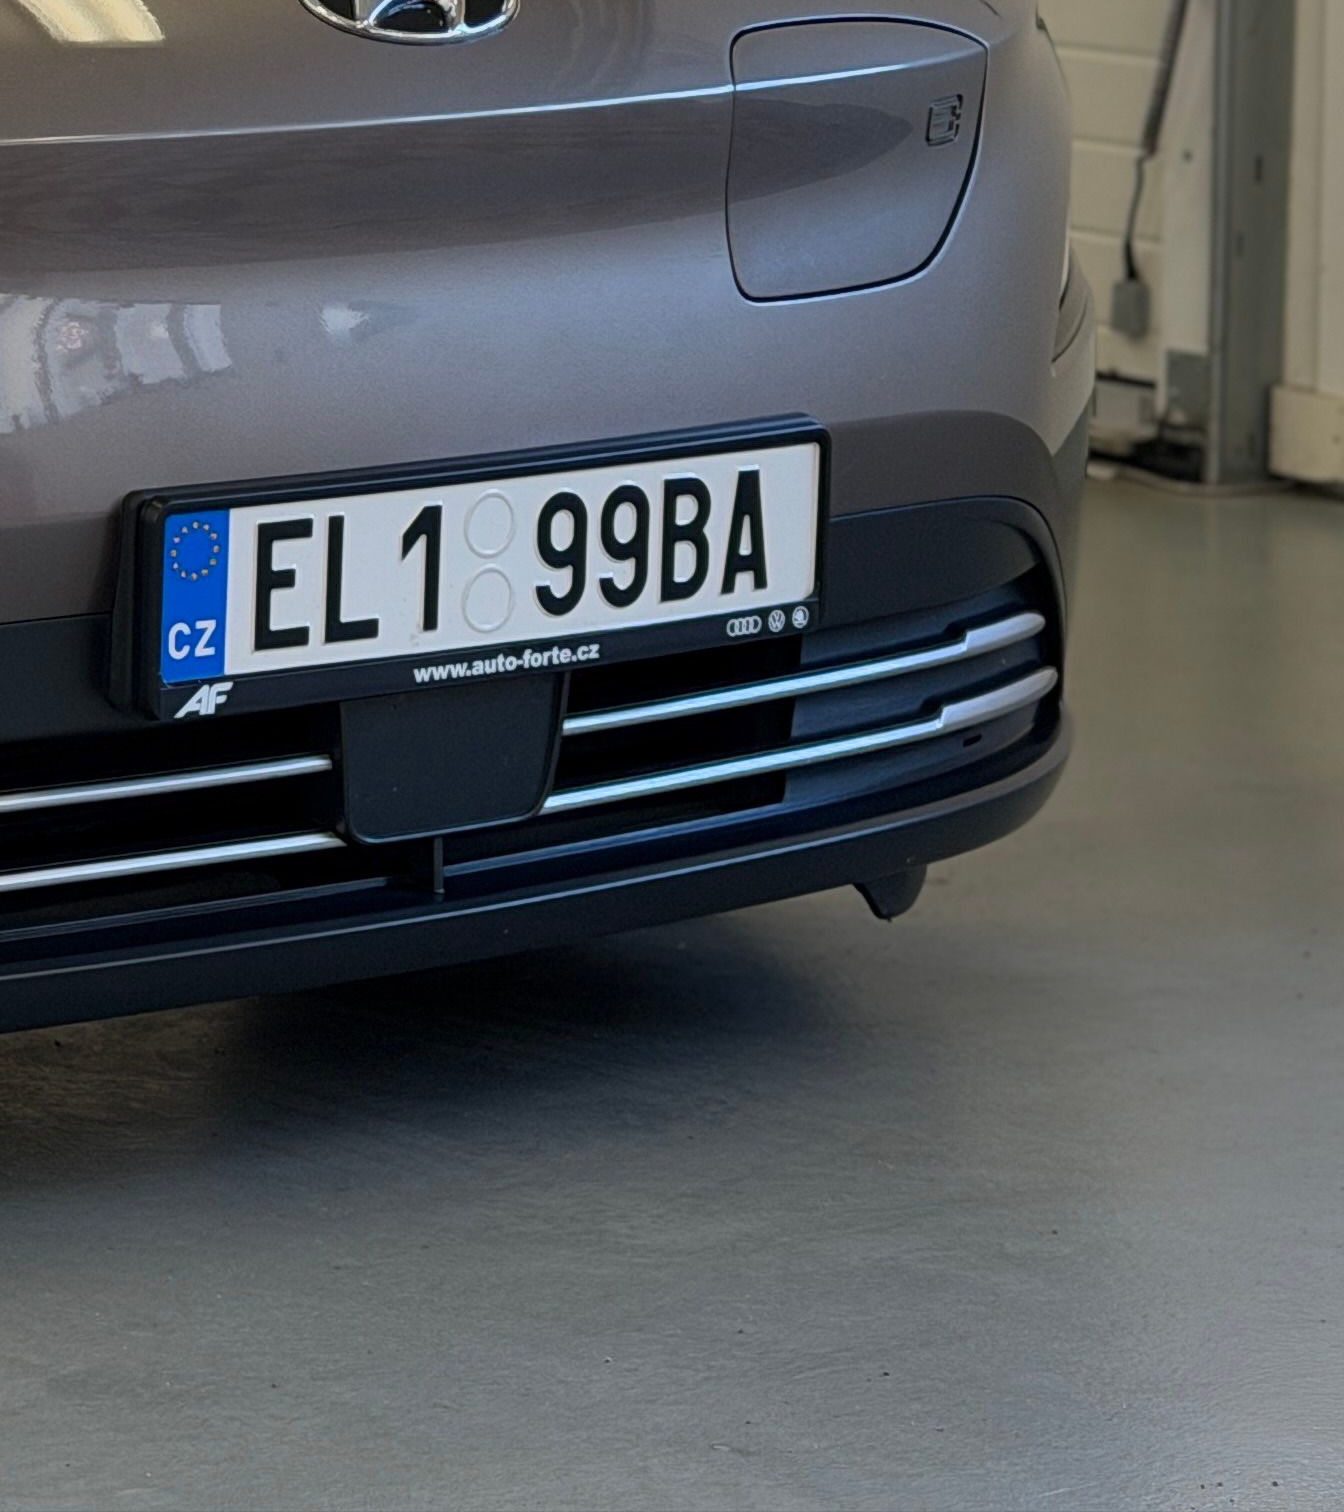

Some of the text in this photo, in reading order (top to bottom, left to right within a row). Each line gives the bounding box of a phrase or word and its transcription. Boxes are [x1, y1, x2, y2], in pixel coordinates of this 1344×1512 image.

[167, 619, 218, 660] CZ
[413, 643, 600, 683] www.auto-forte.cz
[174, 682, 233, 719] AF
